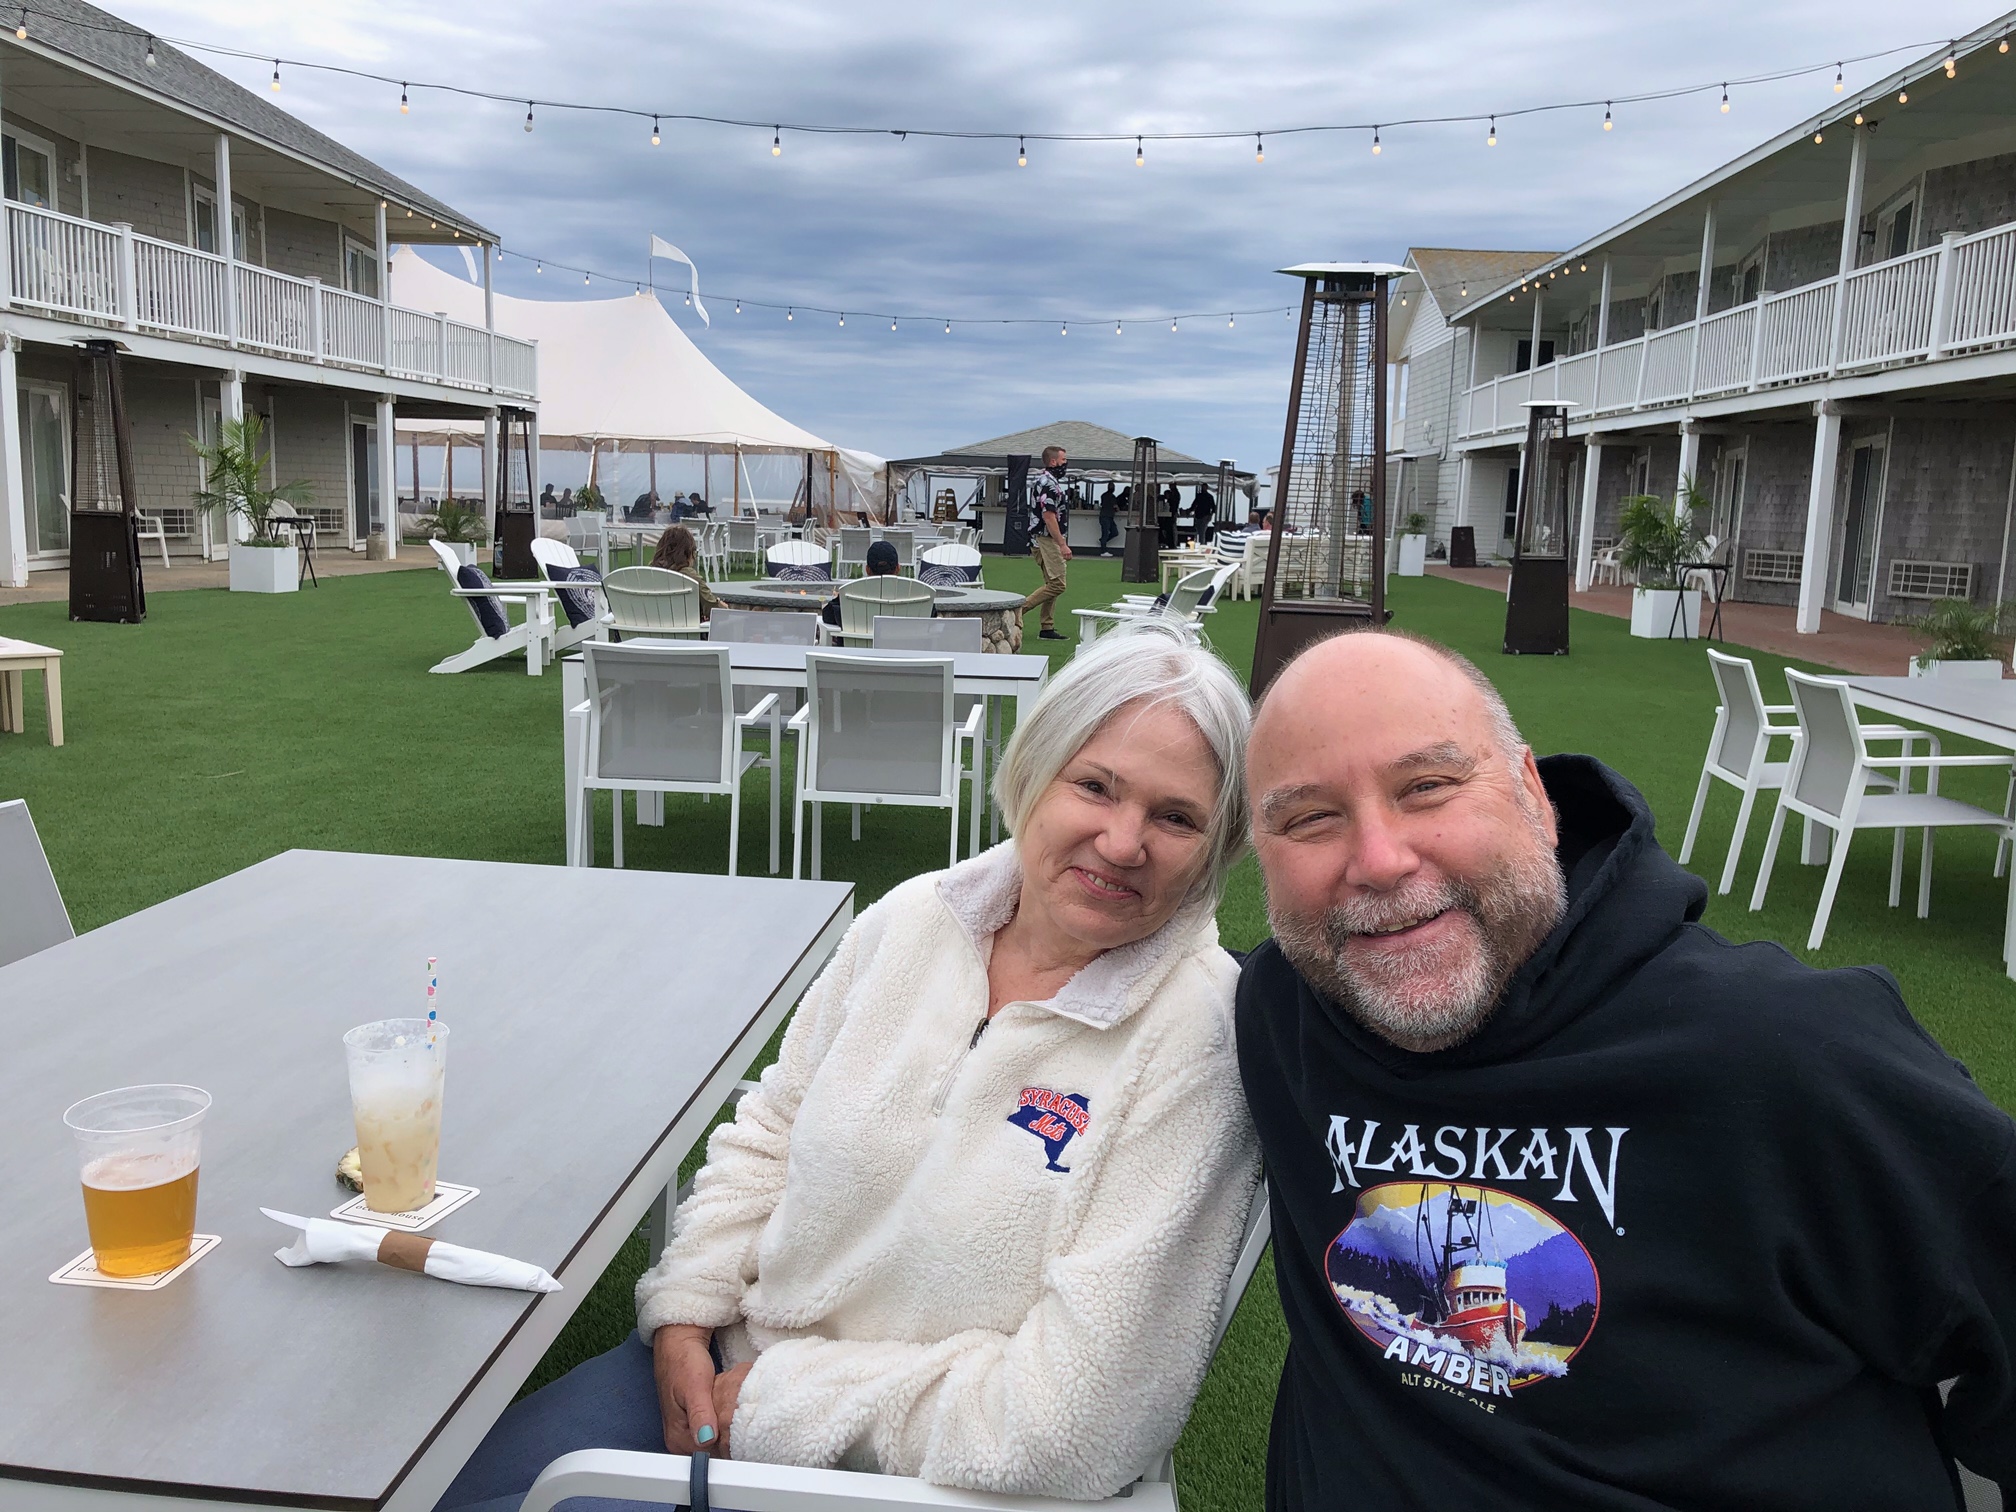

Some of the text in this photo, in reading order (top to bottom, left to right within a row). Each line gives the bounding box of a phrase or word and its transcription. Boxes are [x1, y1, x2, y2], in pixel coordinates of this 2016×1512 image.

[1028, 1113, 1068, 1142] Mets
[1324, 1114, 1630, 1229] ALASKAN
[1384, 1334, 1514, 1398] AMBER
[1401, 1371, 1497, 1415] ALT STYLE ALE
